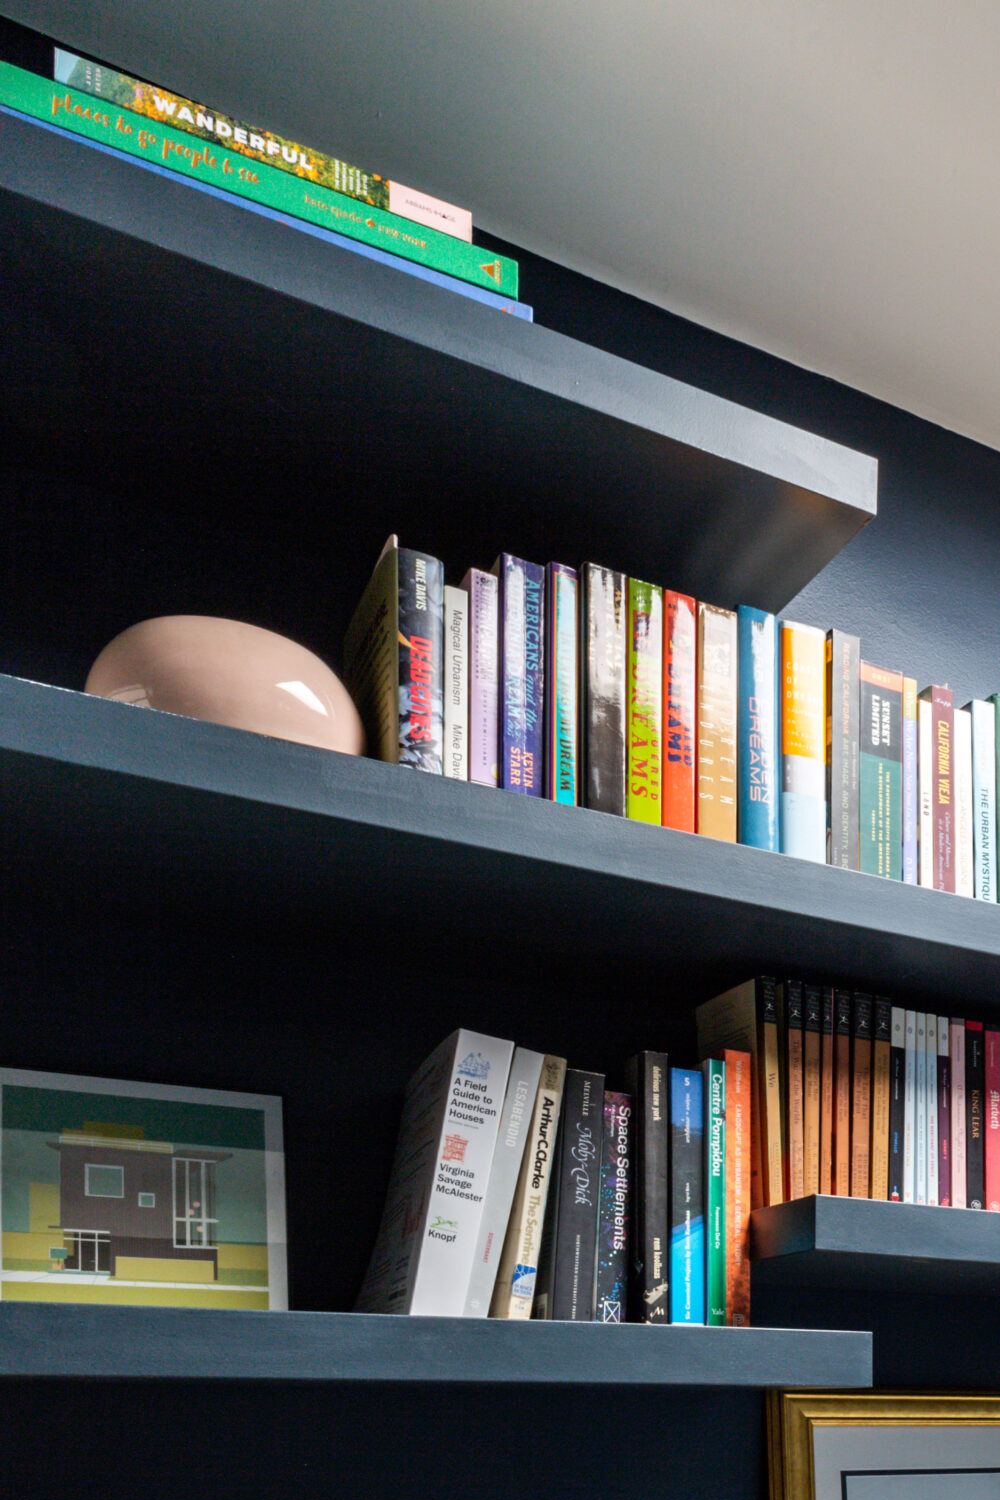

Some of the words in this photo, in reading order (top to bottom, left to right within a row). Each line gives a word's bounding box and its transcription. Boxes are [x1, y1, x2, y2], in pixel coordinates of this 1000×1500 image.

[52, 93, 109, 127] places
[115, 115, 133, 135] to
[138, 129, 157, 149] go
[162, 138, 217, 168] people
[237, 167, 260, 184] see
[152, 94, 313, 170] WANDERFUL
[304, 194, 329, 212] kate
[330, 203, 364, 225] spade
[378, 225, 400, 239] NEW
[402, 232, 429, 249] YORK
[415, 558, 427, 585] MIKE
[415, 584, 427, 611] DAVIS
[450, 609, 463, 652] Magical
[525, 577, 541, 670] AMERICANS
[410, 635, 432, 687] DEAD
[451, 654, 463, 706] Urbanism
[505, 669, 521, 719] DREAM
[667, 661, 682, 763] DREAMS
[842, 683, 850, 735] CALIFORNIA
[410, 686, 433, 742] CITIES
[630, 662, 649, 798] DREAMS
[871, 693, 880, 746] LIMITED
[881, 699, 891, 747] SUNSET
[451, 724, 463, 750] Mike
[699, 685, 714, 801] ENDURES
[749, 696, 761, 802] DREAMS
[938, 720, 950, 775] CALIFORNIA
[510, 746, 521, 785] STARR
[522, 751, 534, 788] KEVIN
[559, 738, 571, 791] DREAM
[938, 778, 950, 805] VIEJA
[981, 787, 989, 809] THE
[981, 810, 989, 849] URBAN
[452, 1088, 480, 1102] Guide
[482, 1095, 493, 1105] to
[454, 1077, 462, 1087] A
[464, 1079, 488, 1093] Field
[581, 1080, 592, 1117] MELVILLE
[652, 1065, 662, 1093] delirious
[711, 1073, 724, 1115] Centre
[448, 1108, 485, 1125] Houses
[450, 1098, 497, 1117] American
[504, 1080, 529, 1148] LESABÉNDIO
[538, 1096, 555, 1140] Arthur
[652, 1093, 662, 1107] new
[652, 1106, 662, 1121] york
[971, 1089, 980, 1114] KING
[990, 1089, 1000, 1130] Macbeth
[615, 1105, 632, 1154] Space
[733, 1103, 743, 1145] LANDSCAPE
[971, 1116, 981, 1139] LEAR
[570, 1122, 595, 1207] Moby-Dick
[709, 1117, 723, 1177] Pompidou
[733, 1146, 742, 1157] AS
[437, 1173, 473, 1189] Savage
[439, 1163, 475, 1180] Virginia
[435, 1183, 484, 1203] McAlester
[528, 1194, 542, 1215] The
[612, 1156, 630, 1251] Settlements
[427, 1228, 457, 1244] Knopf
[653, 1237, 662, 1250] rem
[653, 1251, 662, 1280] koolhaas
